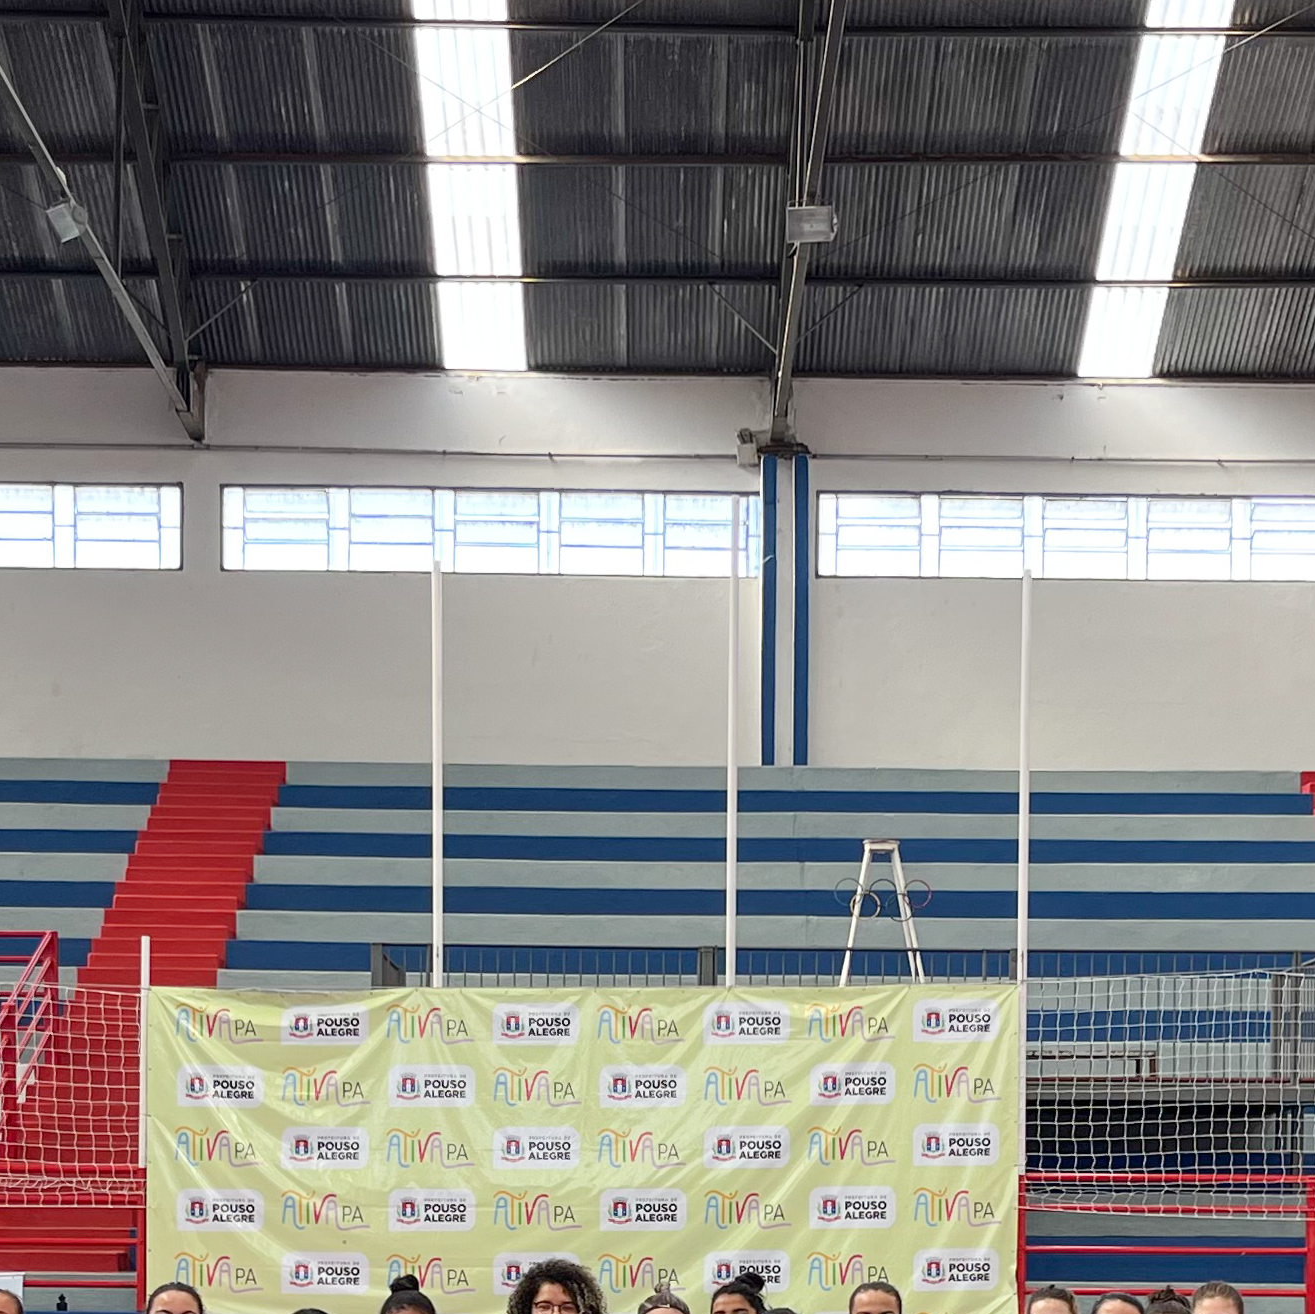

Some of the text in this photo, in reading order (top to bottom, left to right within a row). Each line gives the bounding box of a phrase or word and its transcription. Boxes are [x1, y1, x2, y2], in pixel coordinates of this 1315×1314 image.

[317, 1018, 359, 1027] POUSO
[529, 1017, 571, 1026] POUSO
[739, 1017, 781, 1026] POUSO
[948, 1013, 991, 1023] POUSO
[317, 1028, 359, 1037] ALEGRE
[529, 1027, 571, 1036] ALEGRE
[739, 1027, 781, 1035] ALEGRE
[948, 1024, 991, 1033] ALEGRE
[213, 1080, 255, 1089] POUSO
[424, 1080, 466, 1089] POUSO
[635, 1080, 677, 1089] POUSO
[844, 1077, 886, 1086] POUSO
[213, 1090, 255, 1099] ALEGRE
[424, 1090, 466, 1098] ALEGRE
[635, 1090, 677, 1098] ALEGRE
[844, 1087, 886, 1096] ALEGRE
[318, 1141, 360, 1151] POUSO
[529, 1142, 571, 1151] POUSO
[739, 1140, 781, 1150] POUSO
[949, 1138, 991, 1147] POUSO
[318, 1152, 360, 1160] ALEGRE
[529, 1152, 571, 1160] ALEGRE
[739, 1151, 781, 1159] ALEGRE
[949, 1148, 991, 1157] ALEGRE
[213, 1204, 255, 1213] POUSO
[424, 1204, 466, 1213] POUSO
[635, 1203, 677, 1212] POUSO
[844, 1201, 887, 1210] POUSO
[213, 1214, 255, 1223] ALEGRE
[424, 1214, 466, 1222] ALEGRE
[635, 1213, 677, 1222] ALEGRE
[844, 1211, 887, 1220] ALEGRE
[317, 1267, 360, 1276] POUSO
[948, 1263, 991, 1272] POUSO
[317, 1277, 360, 1285] ALEGRE
[948, 1273, 991, 1282] ALEGRE
